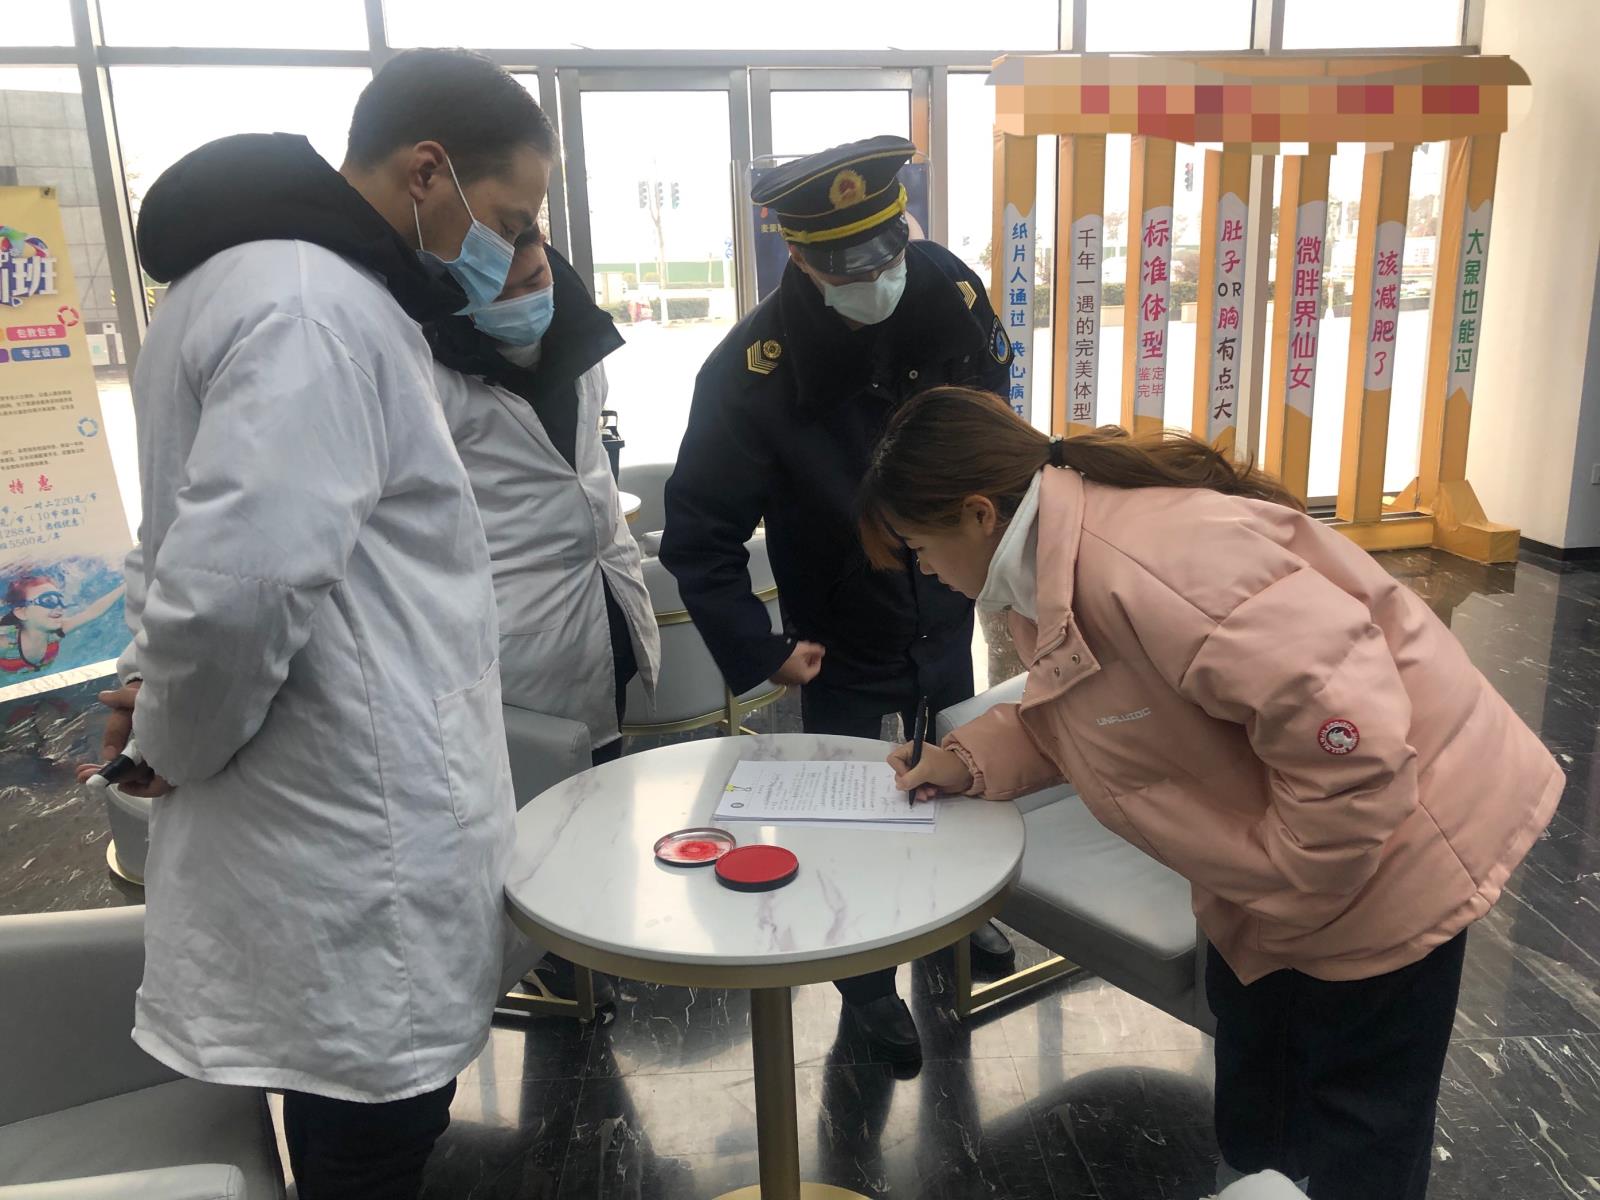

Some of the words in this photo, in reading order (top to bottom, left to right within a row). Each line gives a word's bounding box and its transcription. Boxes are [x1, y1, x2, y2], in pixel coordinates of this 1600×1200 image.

[1009, 222, 1029, 327] 纸片人通过
[1073, 228, 1097, 421] 千年一遇的完美体型
[1141, 219, 1169, 360] 标准体型
[1288, 236, 1322, 390] 微胖界仙女
[1371, 250, 1398, 376] 该减肥了
[1454, 228, 1484, 373] 大象也能过
[1138, 366, 1165, 381] 鉴定
